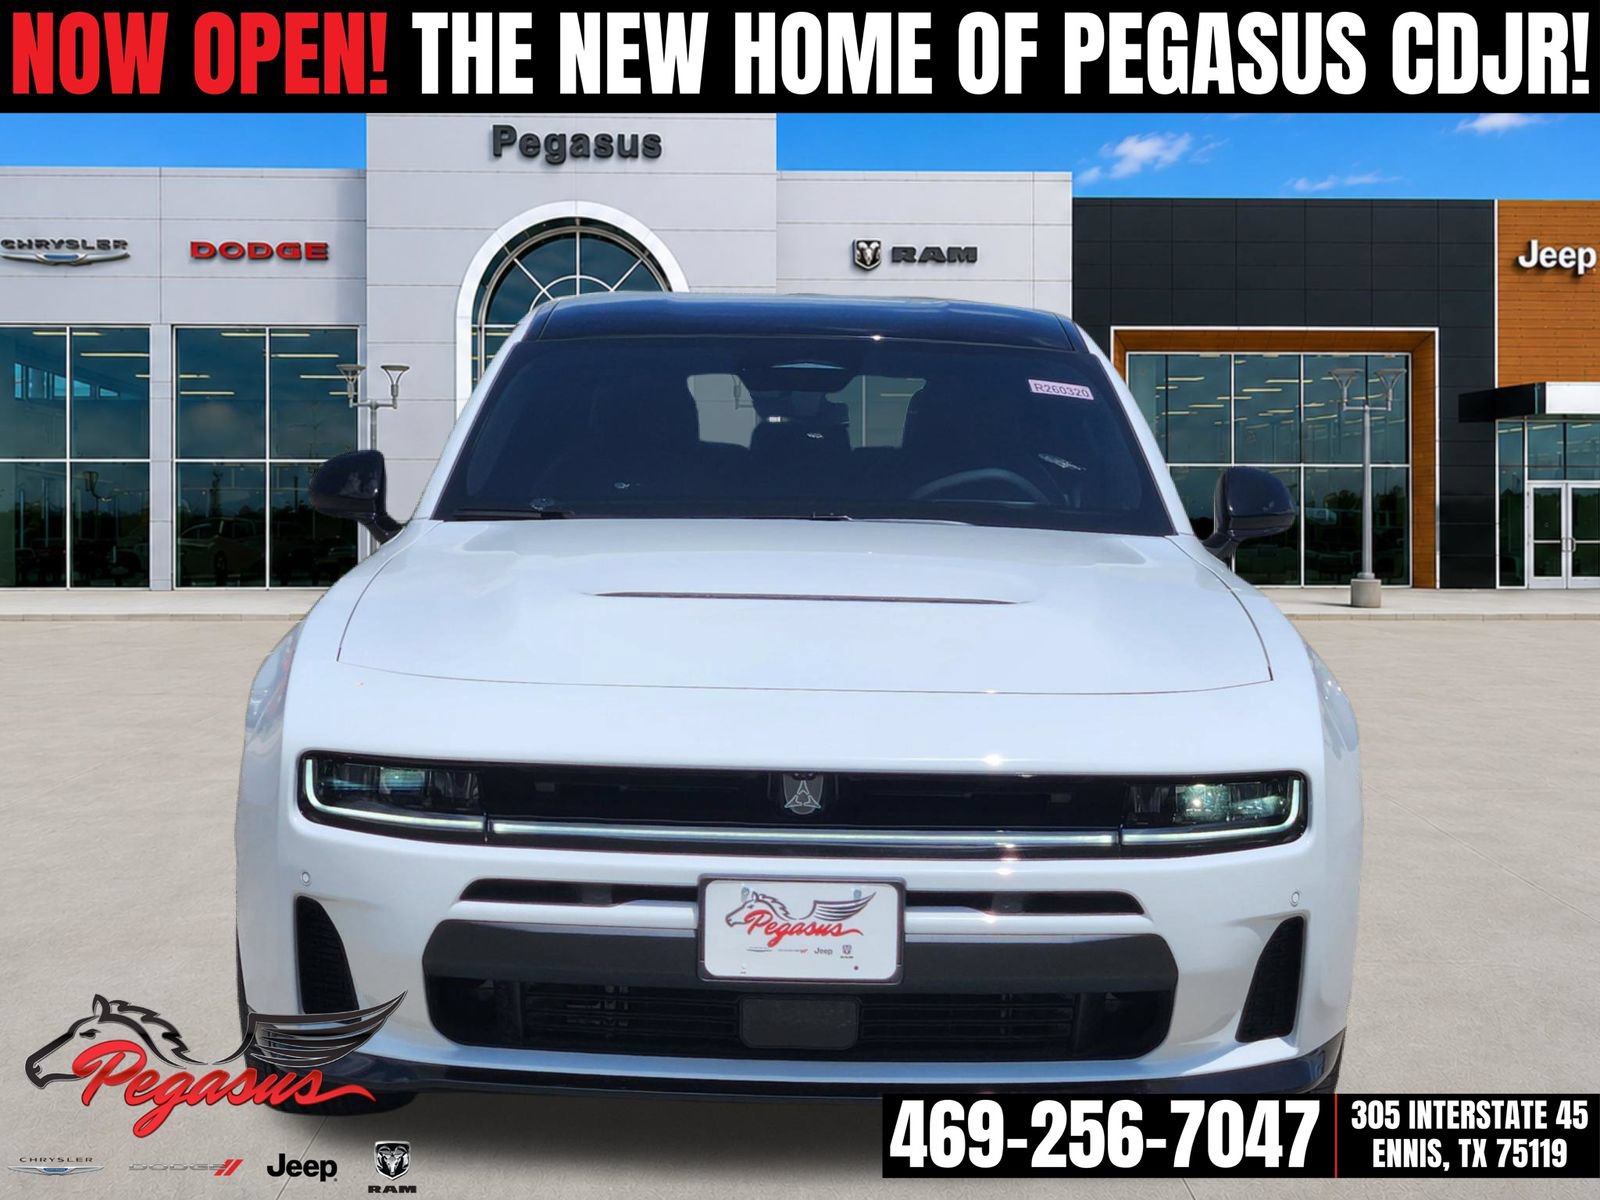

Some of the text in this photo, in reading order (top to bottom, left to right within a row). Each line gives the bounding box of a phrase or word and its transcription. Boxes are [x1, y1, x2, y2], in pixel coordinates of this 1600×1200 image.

[492, 124, 662, 166] Pegasus
[0, 239, 129, 250] CHRYSLER
[189, 241, 329, 261] DODGE
[891, 246, 978, 263] RAM
[1518, 239, 1597, 275] Jeep
[1034, 383, 1090, 398] R260320
[744, 910, 864, 947] Pegasus
